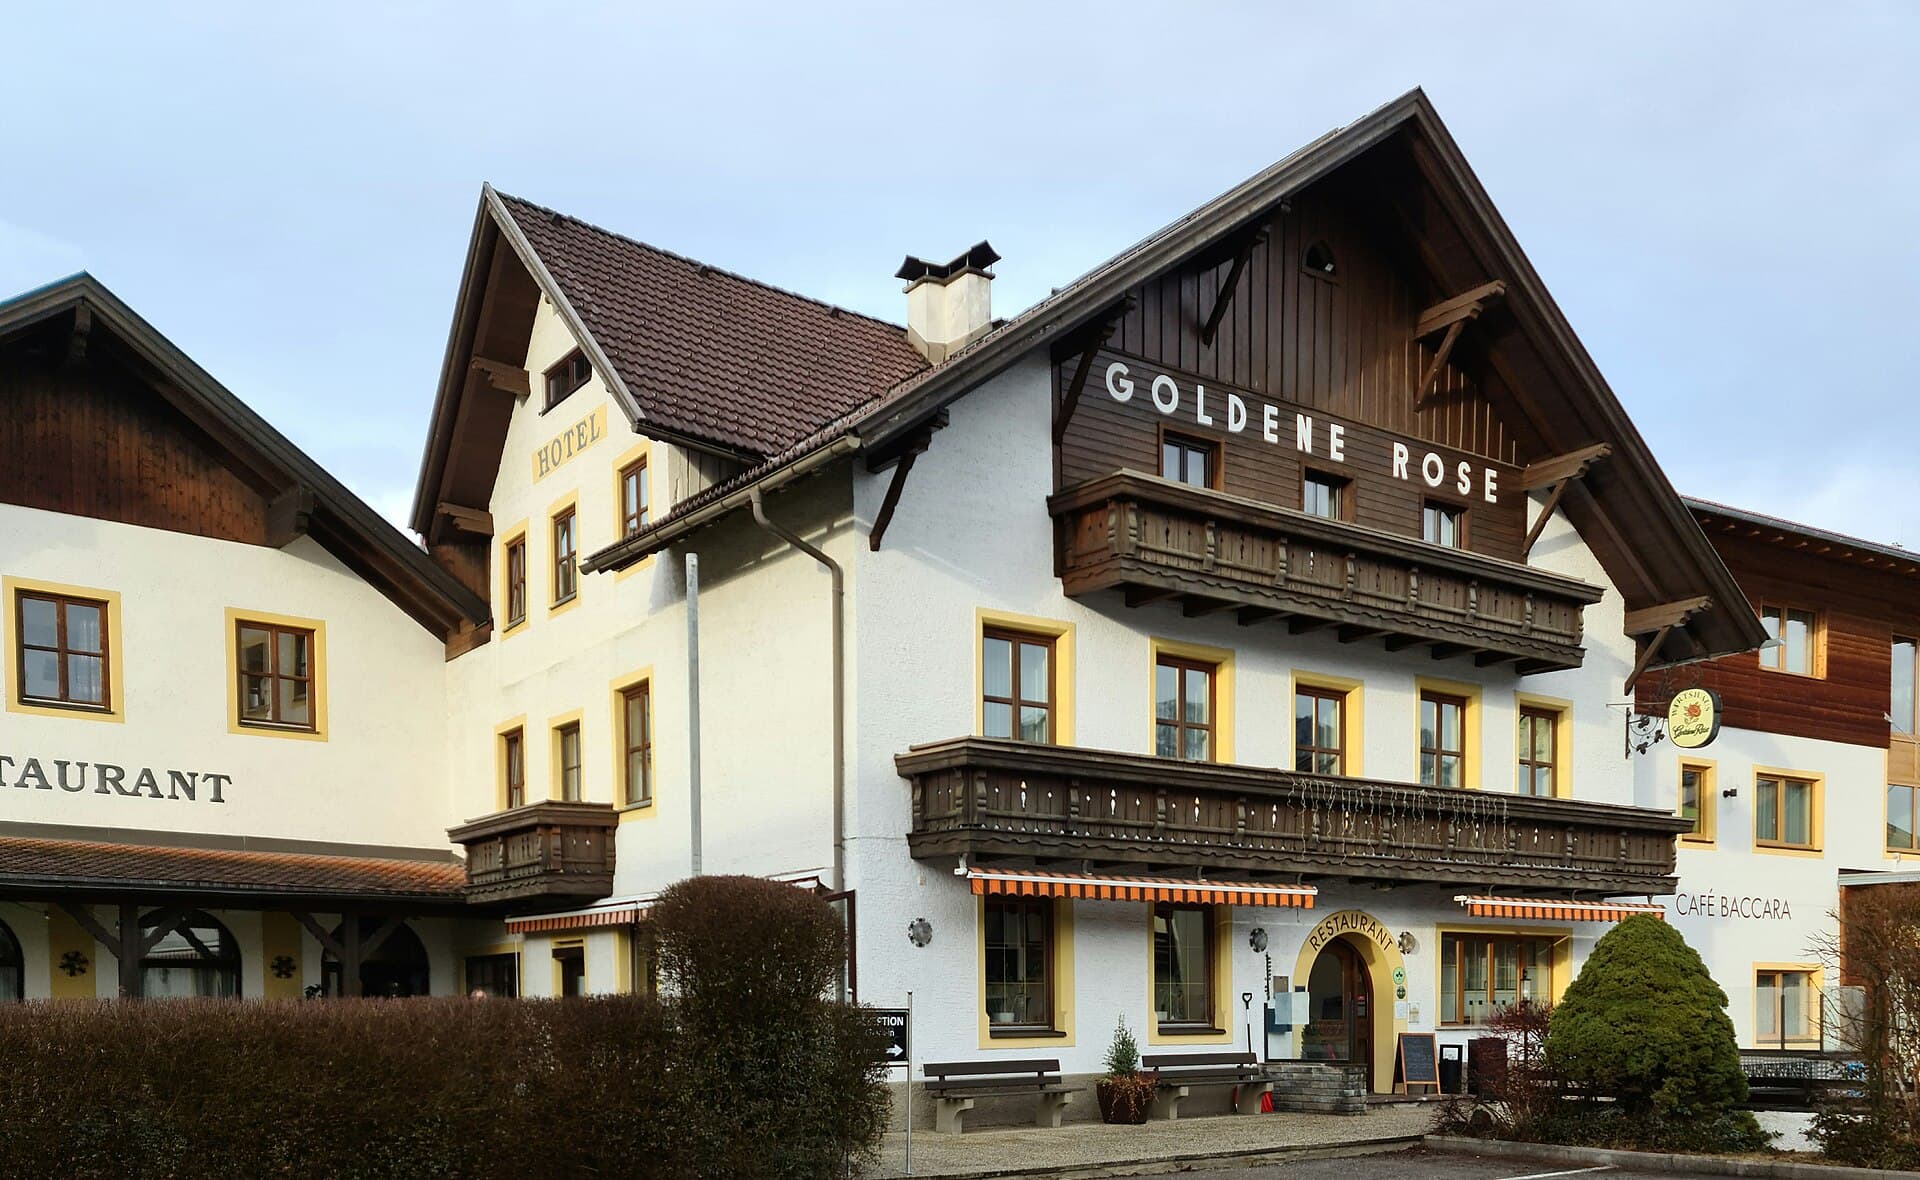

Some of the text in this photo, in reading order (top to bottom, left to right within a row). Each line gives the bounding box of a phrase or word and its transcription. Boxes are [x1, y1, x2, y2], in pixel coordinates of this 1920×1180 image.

[537, 413, 601, 477] HOTEL
[1105, 362, 1498, 503] GOLDENE ROSE
[1676, 888, 1792, 920] CAFÉ BACCARA
[1309, 913, 1393, 952] RESTAURANT
